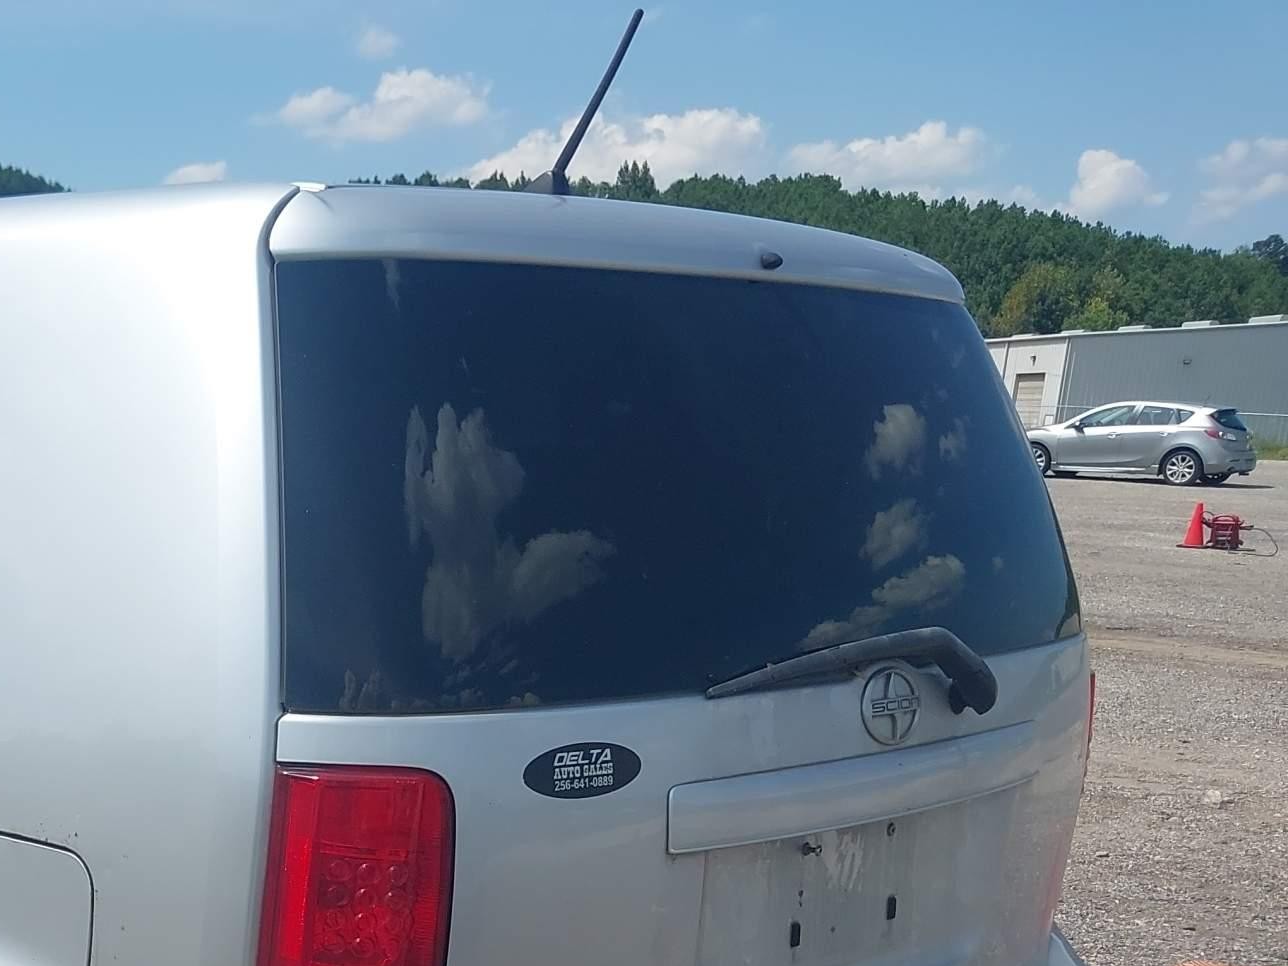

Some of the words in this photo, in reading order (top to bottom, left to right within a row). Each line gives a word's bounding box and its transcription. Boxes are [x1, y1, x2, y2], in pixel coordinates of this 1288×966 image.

[553, 748, 612, 766] DELTA
[553, 767, 581, 780] AUTO
[583, 762, 614, 776] SALES
[554, 775, 614, 792] 256-641-0889
